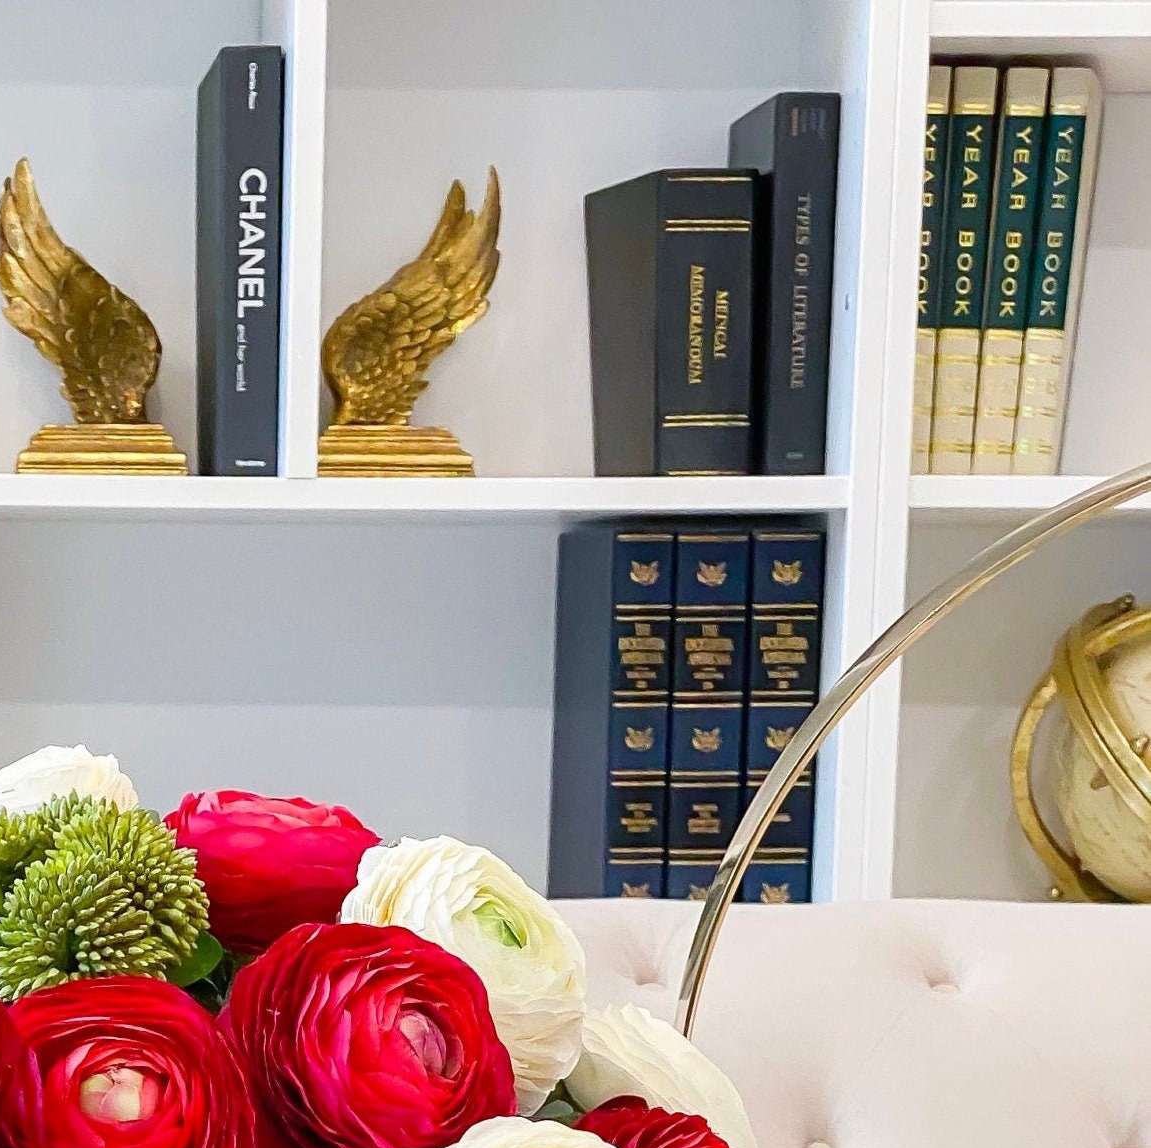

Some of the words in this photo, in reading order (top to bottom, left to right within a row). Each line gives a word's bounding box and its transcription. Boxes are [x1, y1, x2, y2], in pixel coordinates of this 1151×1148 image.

[961, 125, 983, 209] YEAR
[1009, 126, 1032, 210] YEAR
[1051, 127, 1074, 209] YEAR
[237, 168, 267, 318] CHANEL
[794, 193, 812, 245] TYPES
[794, 254, 810, 277] OF
[954, 230, 975, 316] BOOK
[999, 231, 1022, 317] BOOK
[1039, 232, 1063, 316] BOOK
[790, 286, 809, 388] LITERATURE
